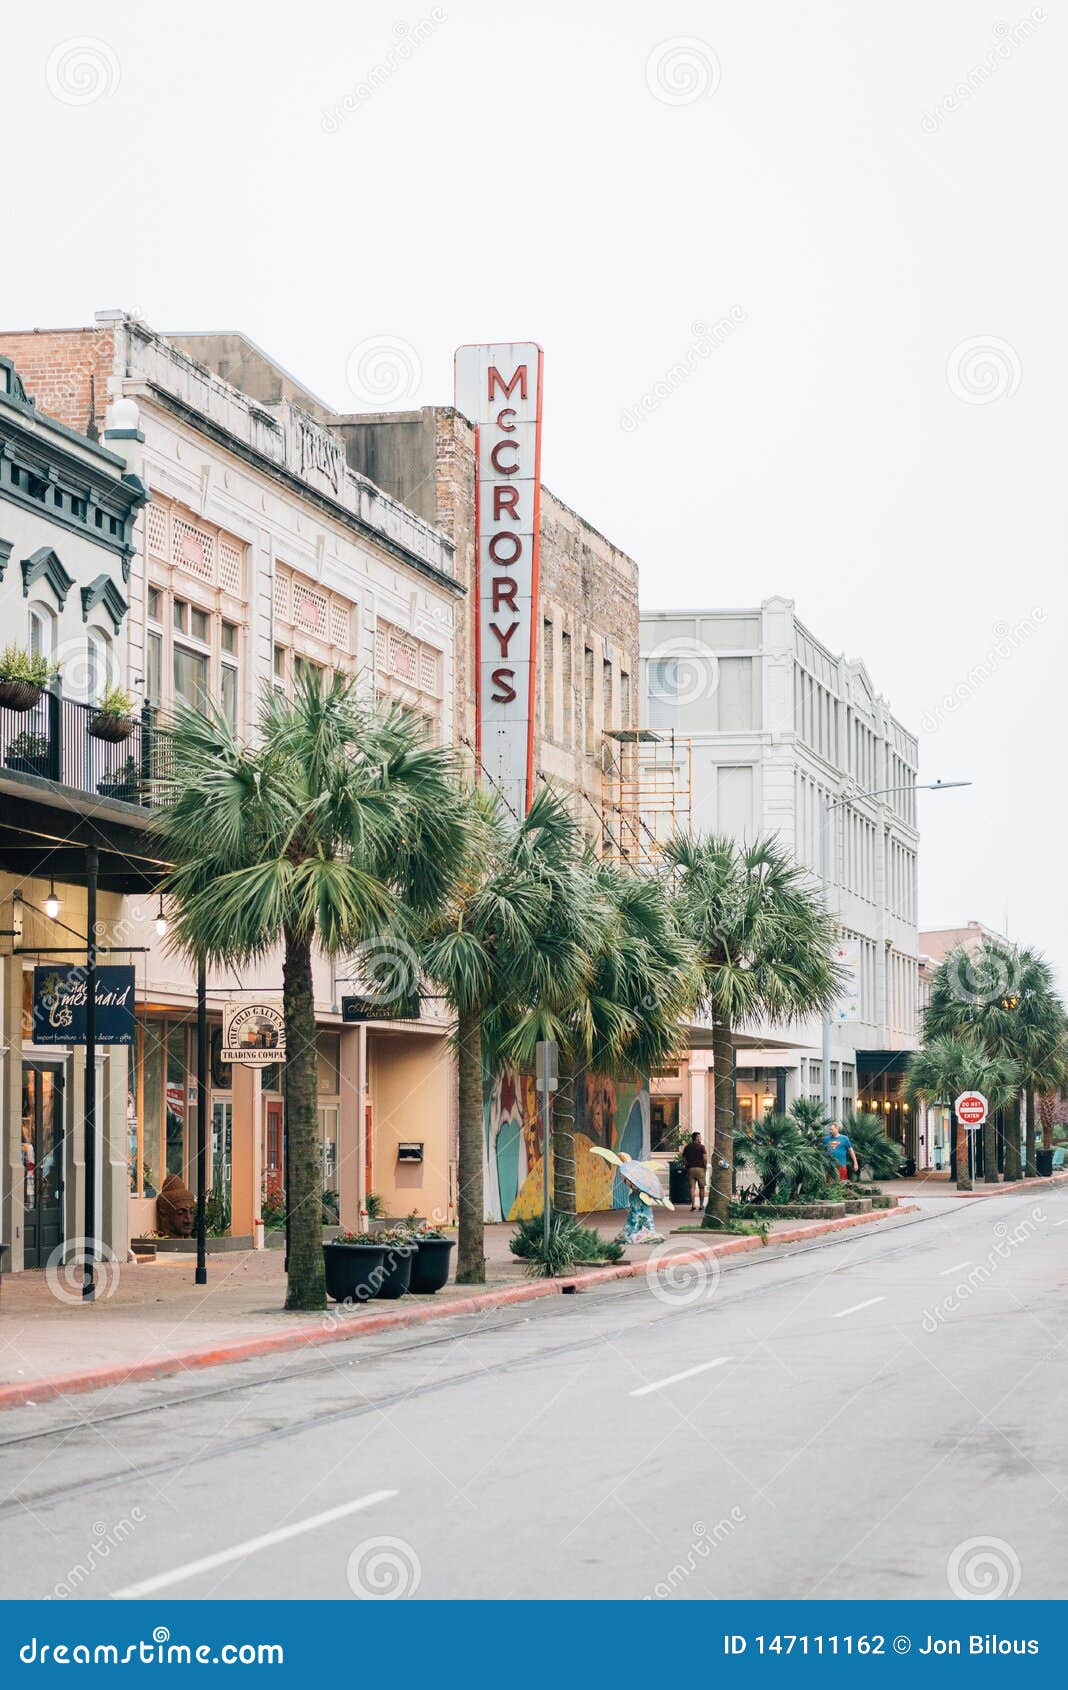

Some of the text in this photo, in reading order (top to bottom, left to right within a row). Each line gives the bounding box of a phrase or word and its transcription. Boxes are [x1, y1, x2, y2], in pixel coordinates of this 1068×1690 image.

[61, 985, 131, 1006] mermaid
[230, 1026, 238, 1047] THE
[234, 1010, 251, 1026] OLD
[223, 1051, 284, 1059] TRADING COMPA
